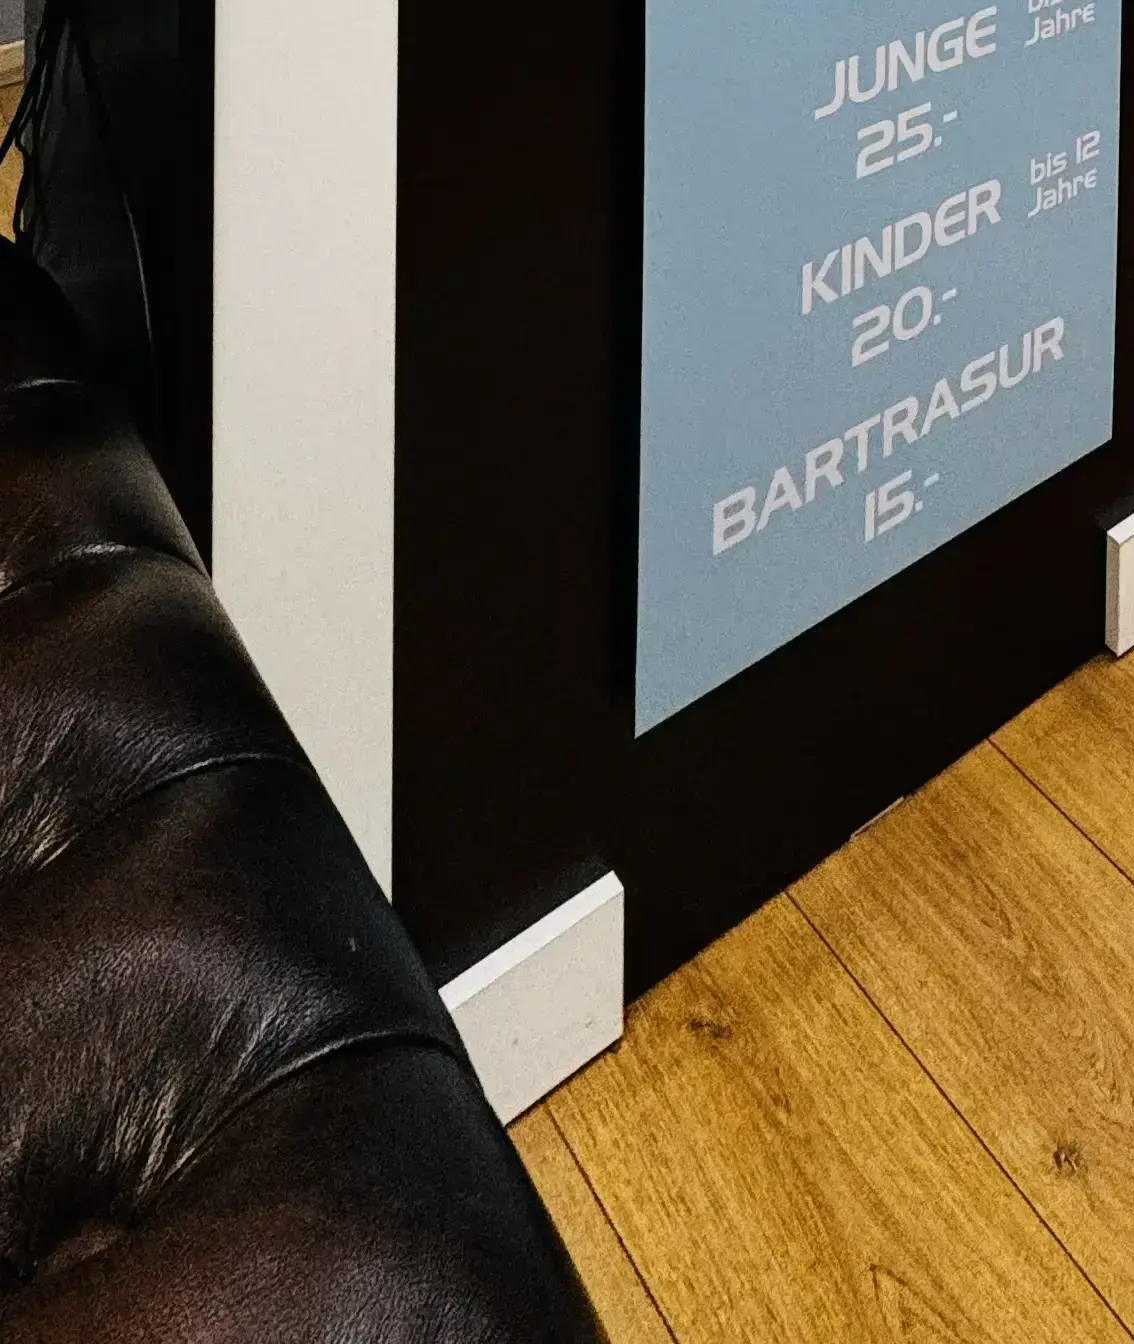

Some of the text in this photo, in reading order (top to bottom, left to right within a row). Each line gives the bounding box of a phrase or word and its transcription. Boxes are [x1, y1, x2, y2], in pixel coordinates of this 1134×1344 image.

[812, 5, 999, 121] JUNGE
[1024, 3, 1096, 48] Jahre
[852, 109, 960, 180] 25.-
[1030, 130, 1103, 187] bis 12
[1027, 167, 1099, 221] Jahre
[800, 177, 1003, 318] KINDER
[851, 283, 960, 369] 20.-
[710, 315, 1066, 557] BARTRASUR
[864, 471, 941, 546] 15.-
